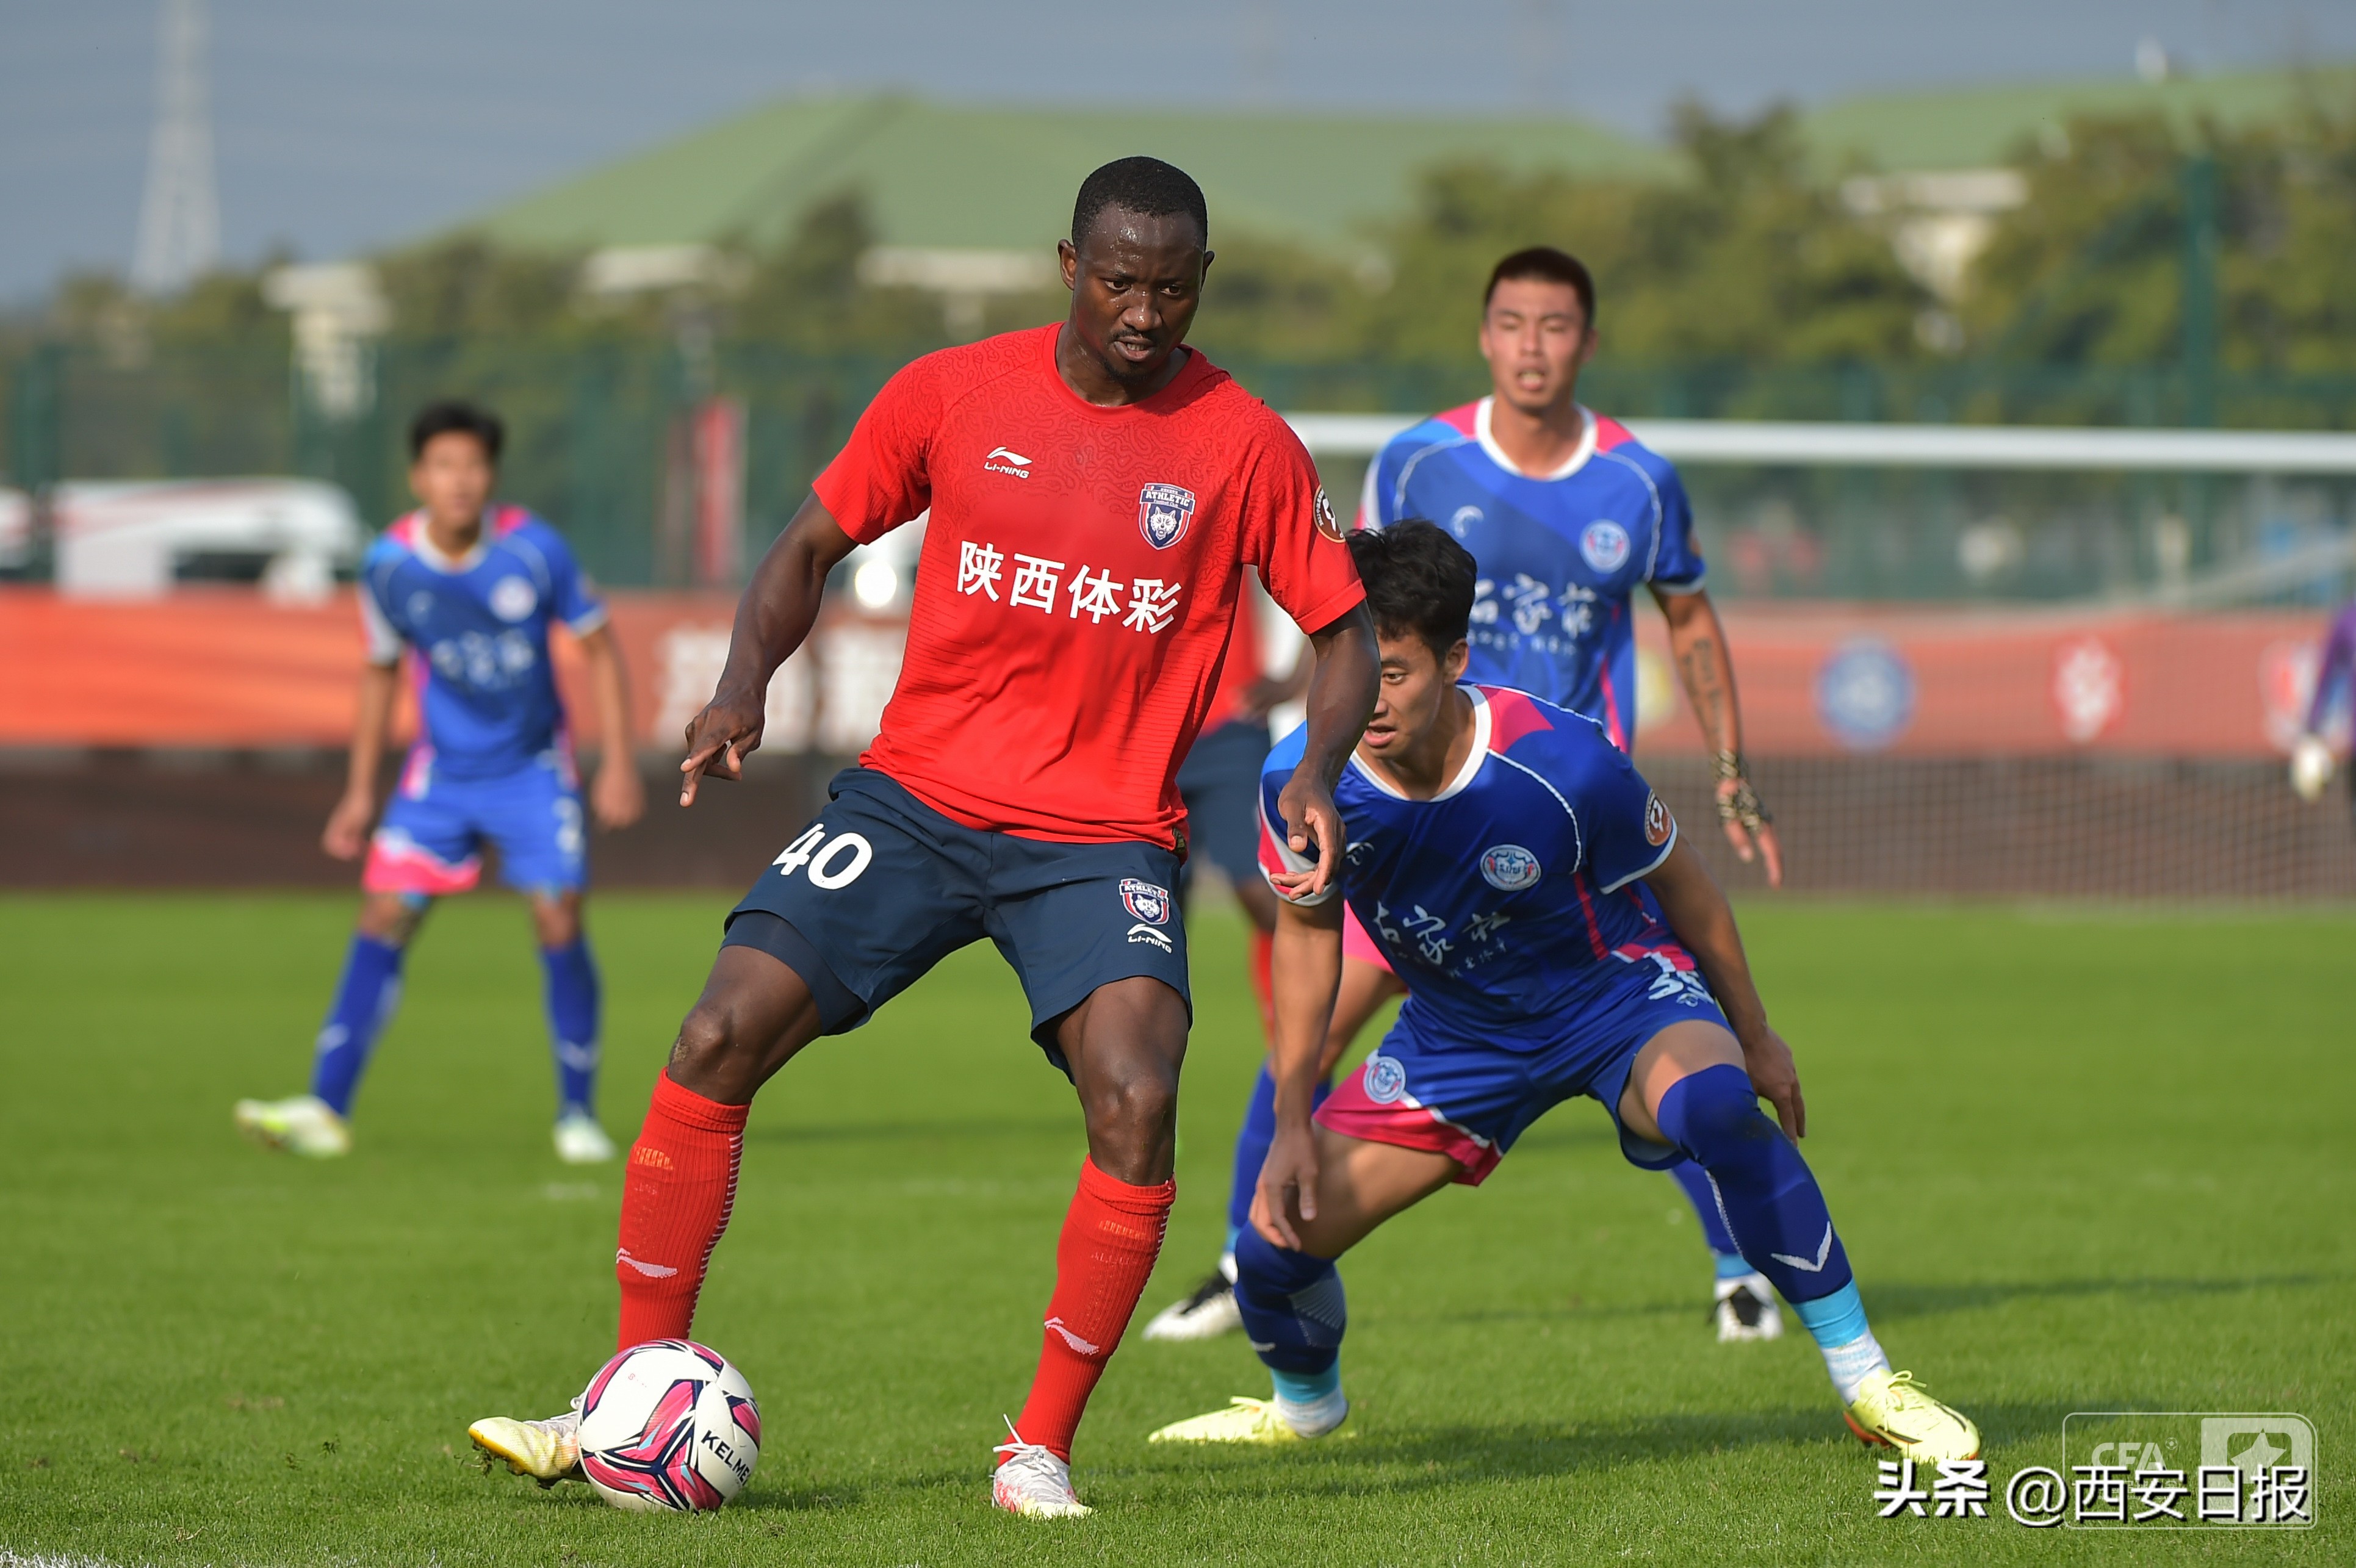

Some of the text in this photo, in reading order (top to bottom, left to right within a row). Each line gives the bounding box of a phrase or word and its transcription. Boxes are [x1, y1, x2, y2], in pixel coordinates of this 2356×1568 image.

[984, 461, 1030, 479] LI-NING
[1145, 491, 1190, 507] ATHLETIC
[956, 540, 1181, 634] 陕西体彩
[772, 823, 873, 890] 40
[1128, 935, 1172, 954] LI-NING
[701, 1430, 750, 1483] KELME
